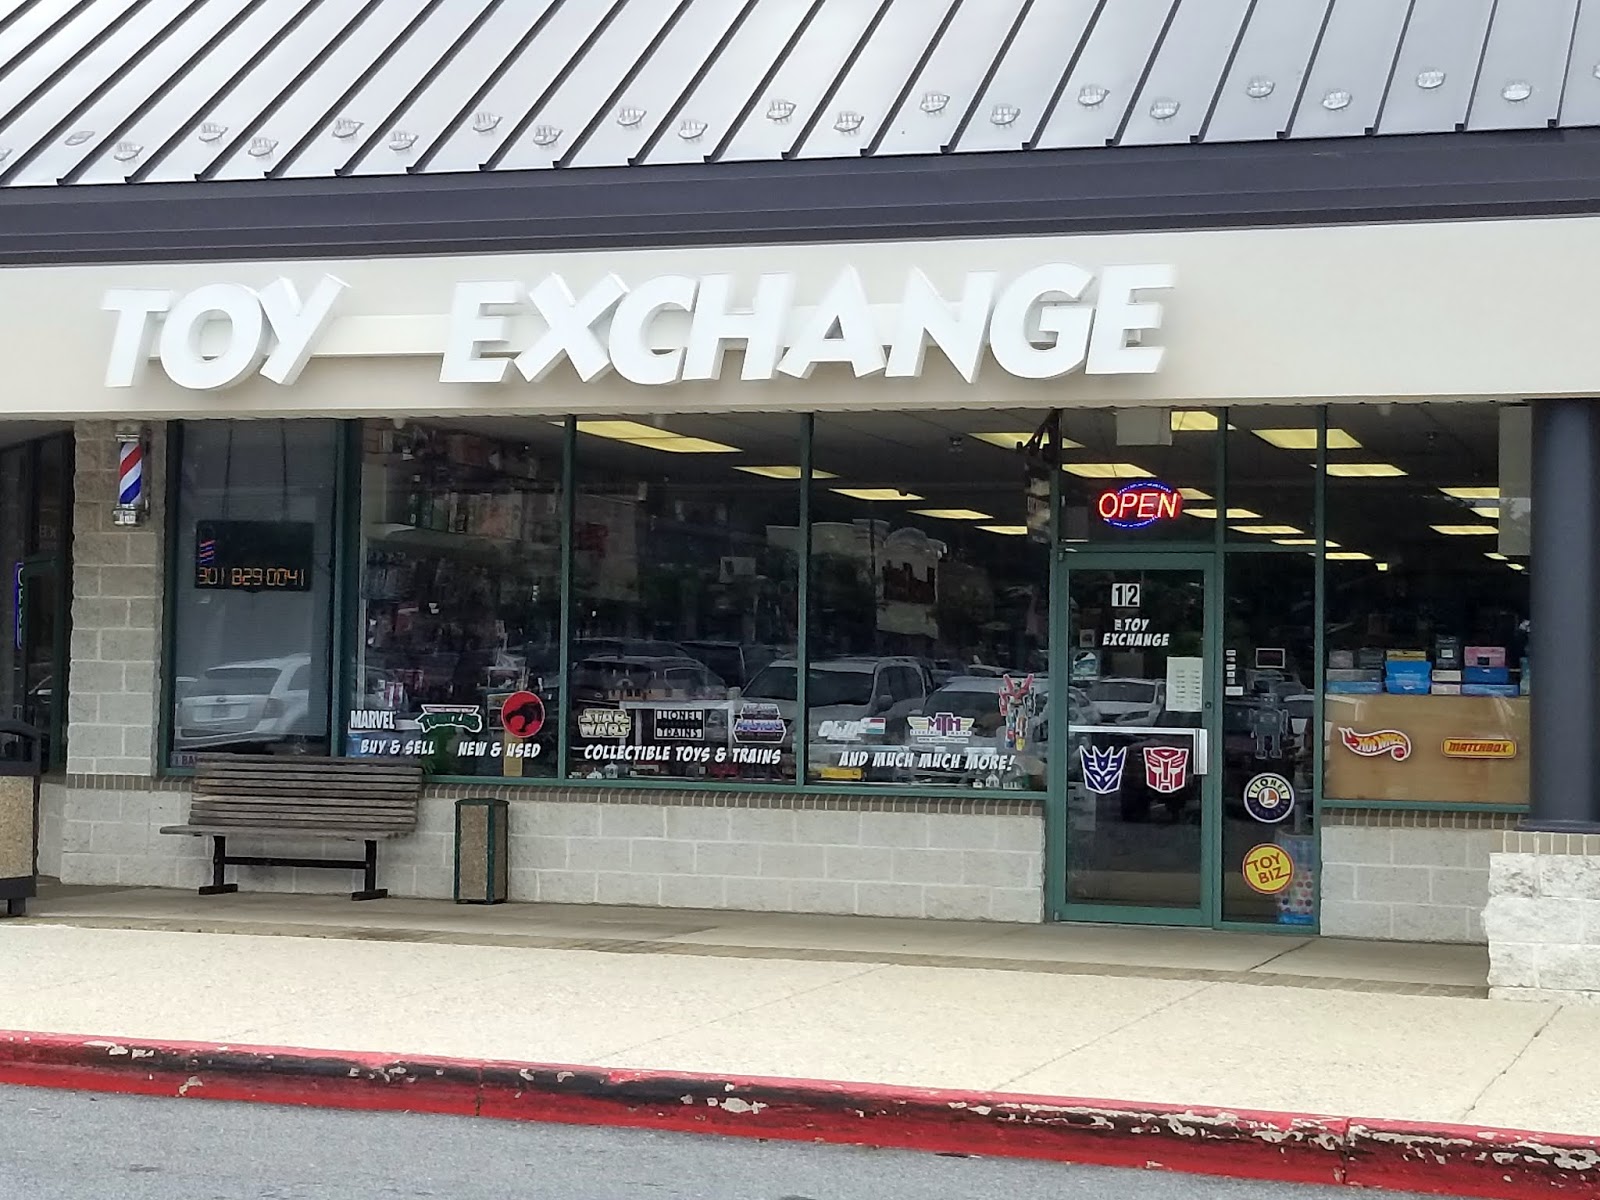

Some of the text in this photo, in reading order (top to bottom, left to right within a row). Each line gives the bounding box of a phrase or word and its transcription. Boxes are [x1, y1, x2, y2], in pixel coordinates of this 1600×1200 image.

[104, 262, 1174, 390] TOY EXCHANGE
[1098, 492, 1178, 518] OPEN
[199, 567, 225, 586] 301
[1115, 585, 1138, 606] 12
[1124, 618, 1150, 632] TOY
[1102, 632, 1170, 647] EXCHANGE
[350, 710, 396, 730] MARVEL
[579, 709, 630, 724] STAR
[656, 710, 703, 721] LIONEL
[580, 722, 630, 737] WARS
[656, 727, 703, 738] TRAINS
[927, 713, 962, 736] MTH
[360, 739, 435, 756] BUY & SELL
[457, 741, 542, 758] NEW & USED
[584, 744, 781, 765] COLLECTIBLE TOYS & TRAINS
[1448, 741, 1510, 753] MATCHBOX
[838, 750, 1017, 771] AND MUCH MUCH MORE!
[1251, 778, 1289, 795] LIONEL
[1246, 852, 1281, 872] TOY
[1257, 866, 1290, 884] BIZ
